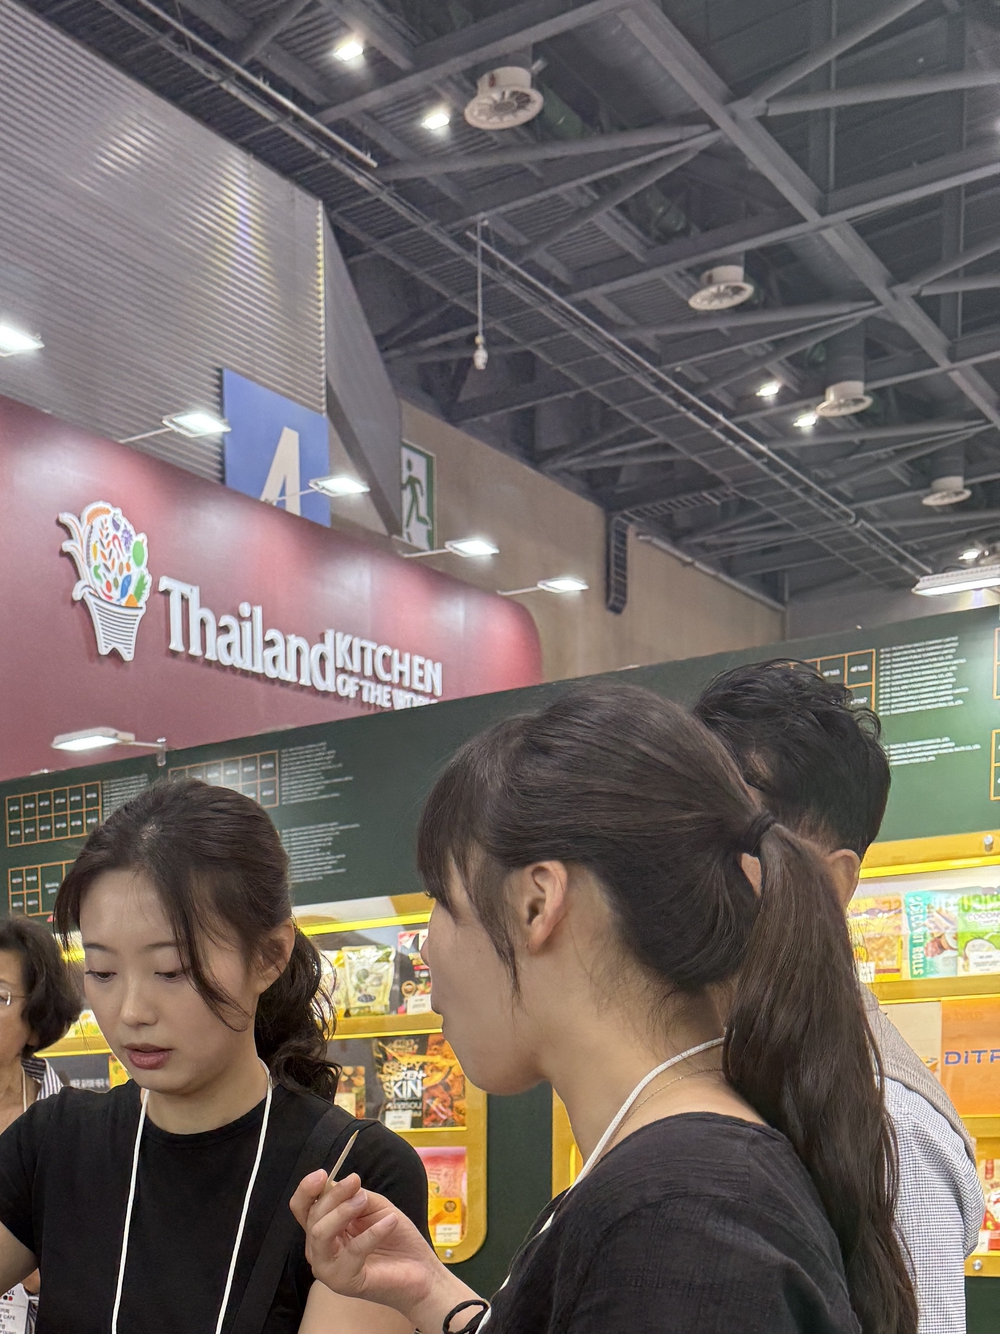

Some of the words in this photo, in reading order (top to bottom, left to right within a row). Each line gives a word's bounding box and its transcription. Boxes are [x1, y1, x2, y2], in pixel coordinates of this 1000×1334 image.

[260, 427, 302, 516] A
[158, 575, 336, 692] Thailand
[335, 631, 442, 697] KITCHEN
[335, 674, 360, 698] OF
[360, 680, 392, 708] THE
[382, 1080, 423, 1099] SKIN
